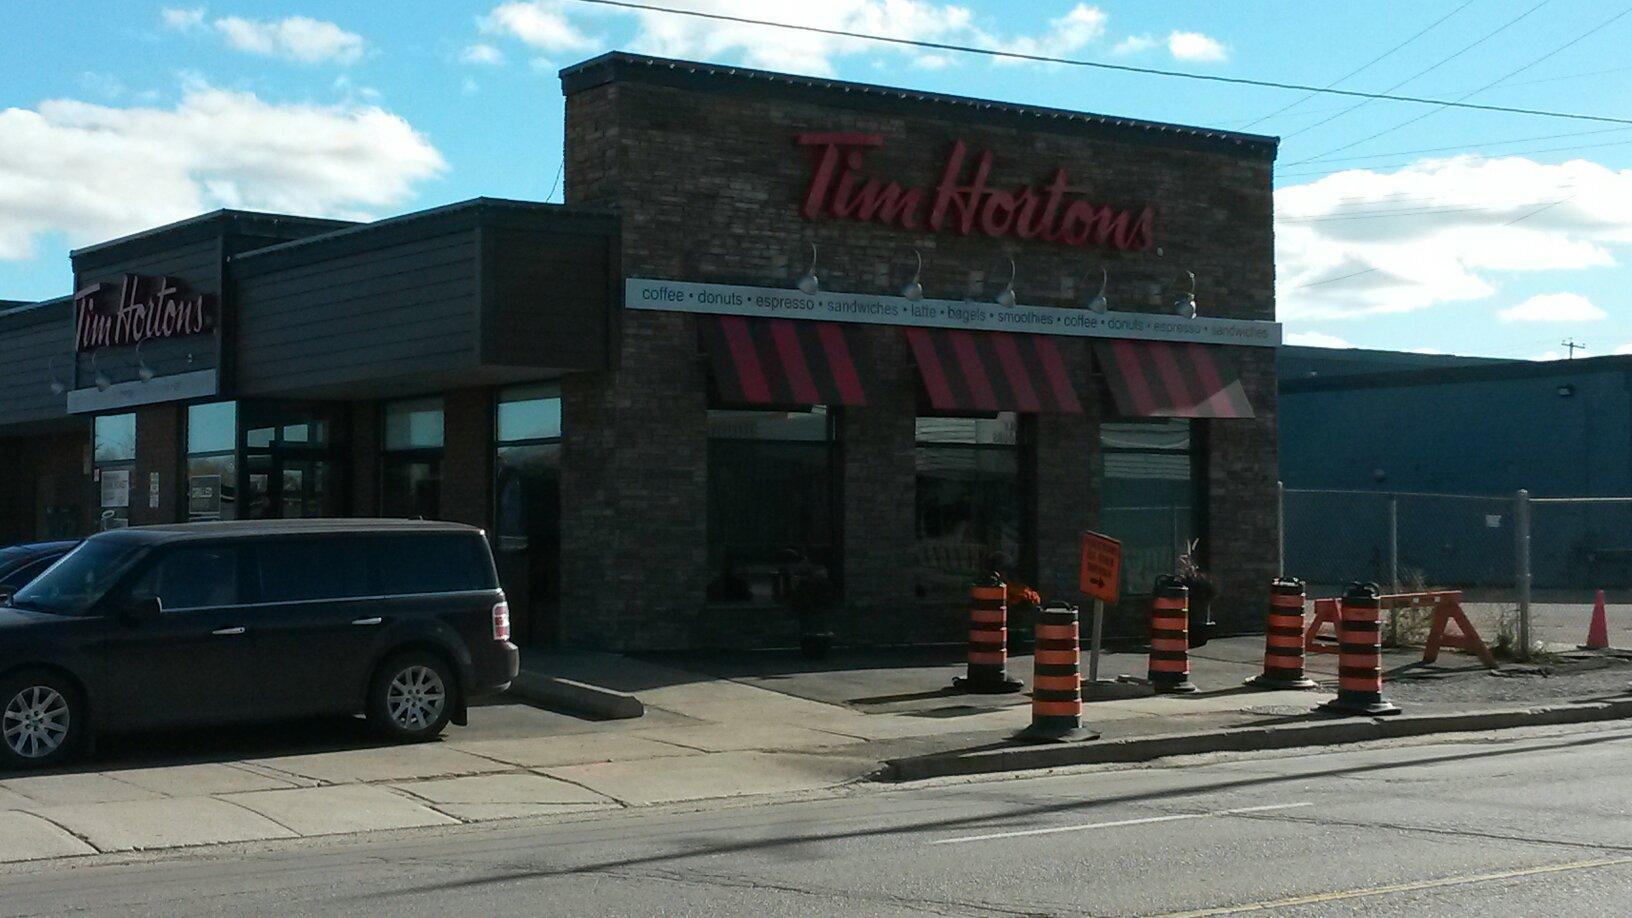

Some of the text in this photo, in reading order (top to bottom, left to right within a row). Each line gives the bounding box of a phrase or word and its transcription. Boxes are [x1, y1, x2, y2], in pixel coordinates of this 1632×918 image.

[796, 132, 1157, 251] Tim Hortons
[75, 273, 205, 353] Tim Hortons
[642, 286, 1269, 339] coffee donuts espresso sandwiches latte bagels smoothies coffee donuts espresso sandwiches
